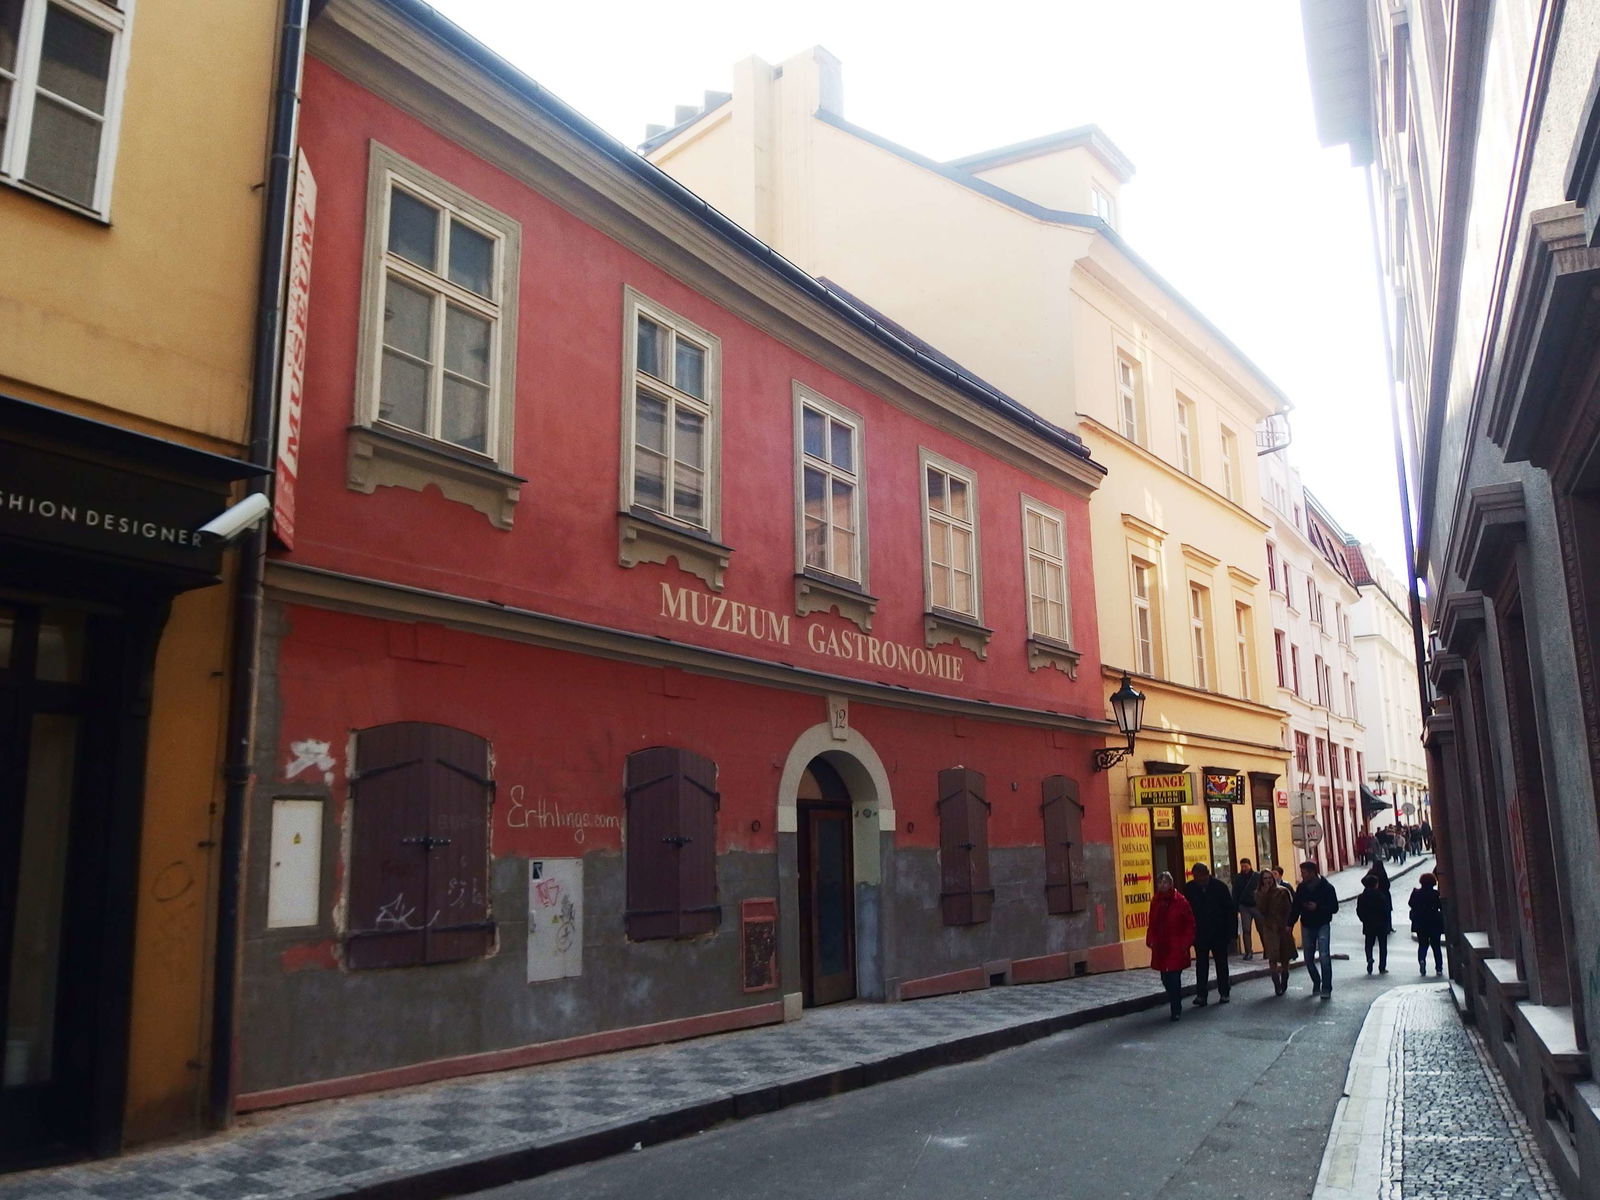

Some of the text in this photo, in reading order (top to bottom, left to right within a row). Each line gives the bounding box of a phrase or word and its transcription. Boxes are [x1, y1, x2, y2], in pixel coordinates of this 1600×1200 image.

[286, 209, 312, 458] MUSEUM
[86, 510, 202, 548] DESIGNER
[660, 582, 965, 682] MUZEUM GASTRONOMIE
[834, 709, 846, 729] 12
[1140, 775, 1185, 789] CHANGE
[1141, 791, 1179, 799] WESTERN
[1120, 822, 1149, 838] CHANGE
[1182, 821, 1206, 836] CHANGE
[1123, 873, 1138, 886] ATM
